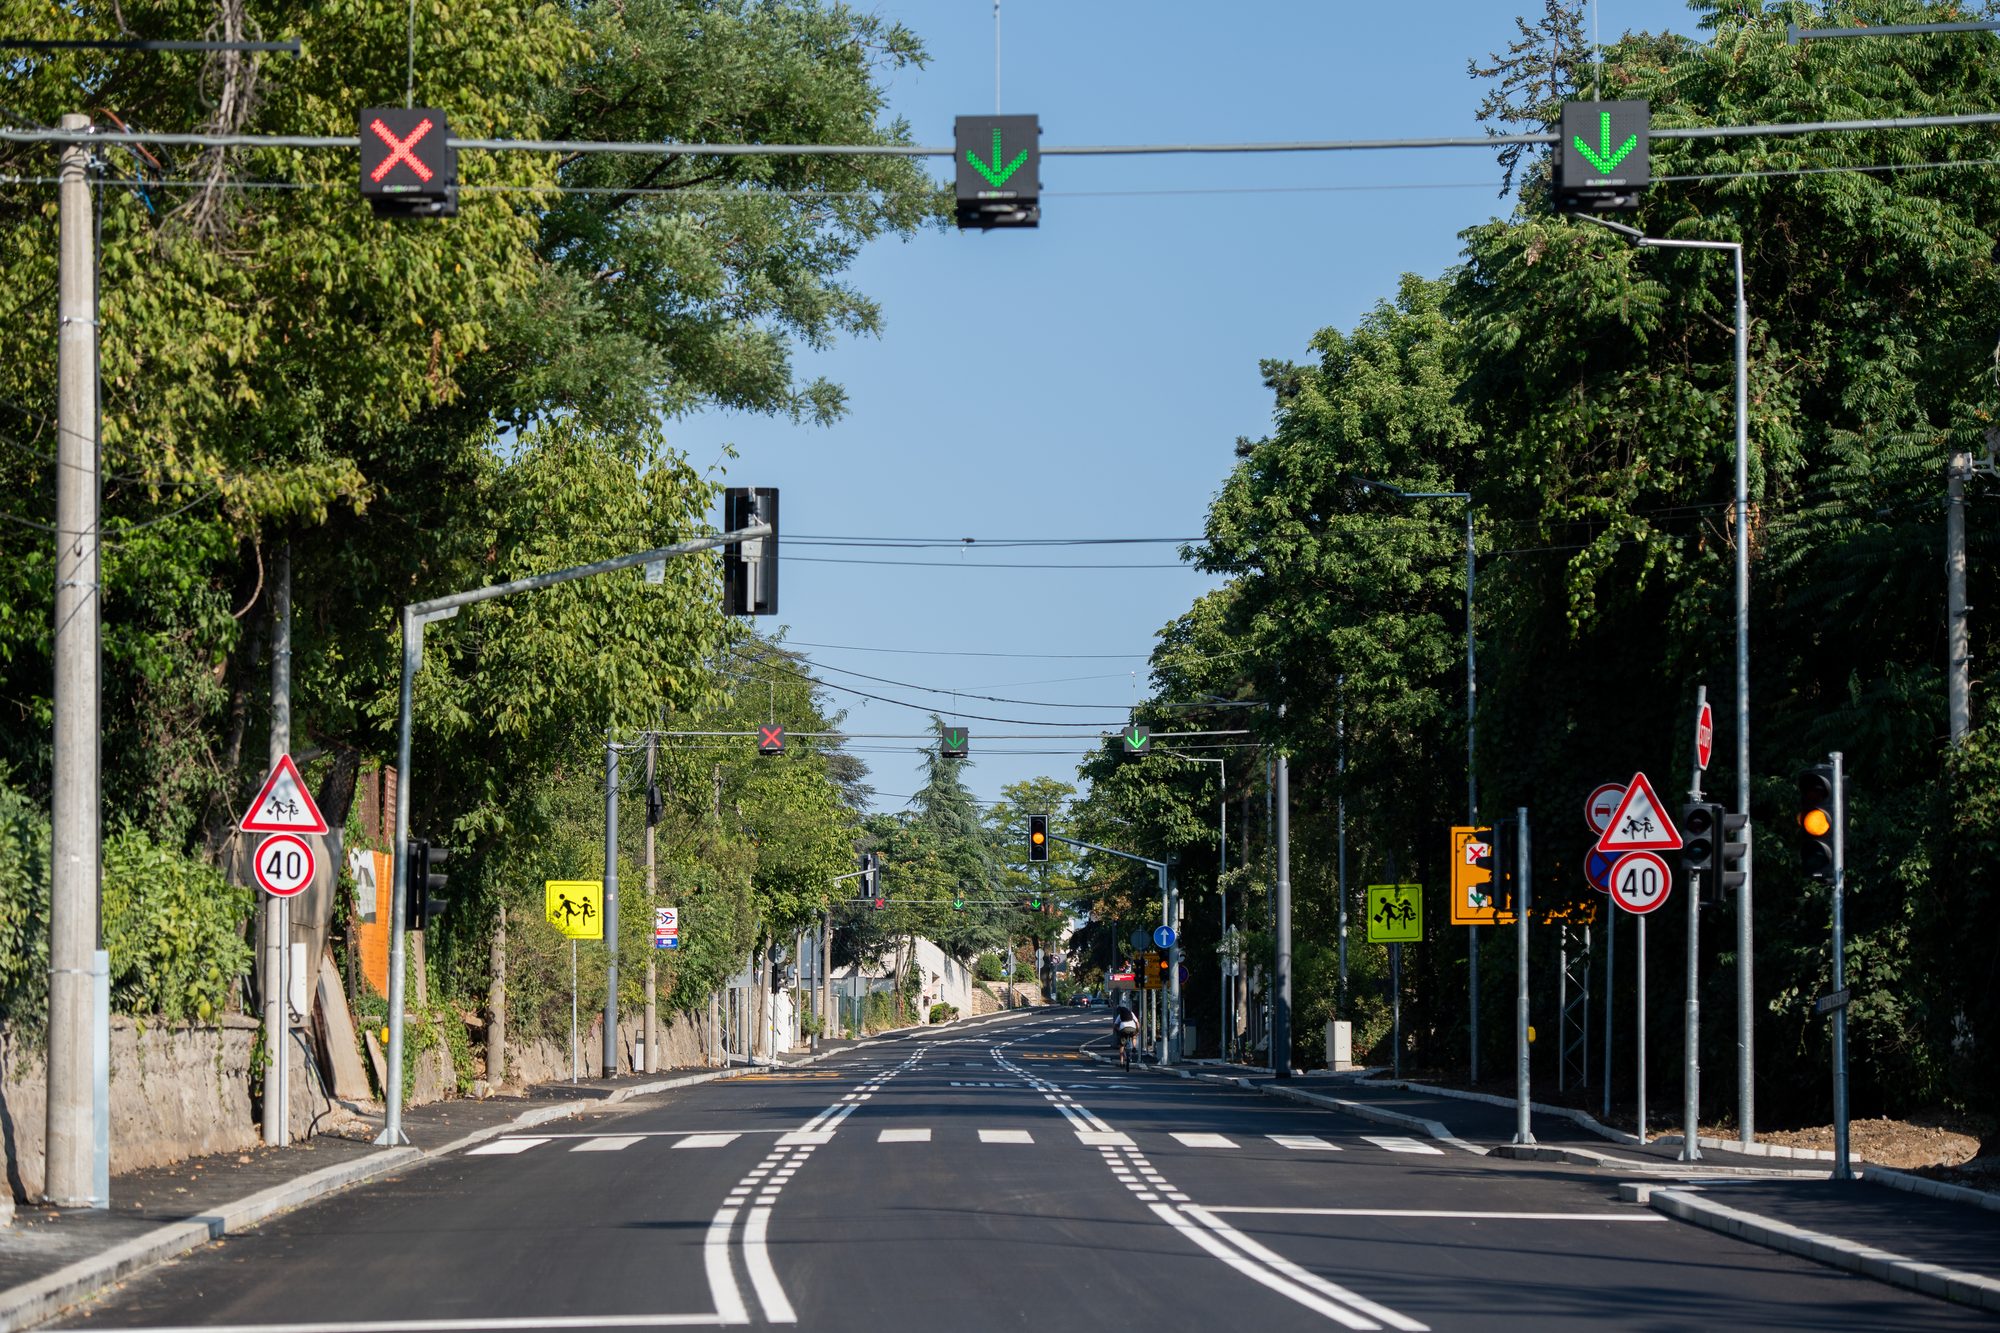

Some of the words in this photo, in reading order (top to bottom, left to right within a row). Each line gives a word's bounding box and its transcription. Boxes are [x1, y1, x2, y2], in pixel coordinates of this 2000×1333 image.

[1700, 724, 1711, 748] STOP
[266, 851, 301, 880] 40
[1622, 868, 1657, 897] 40
